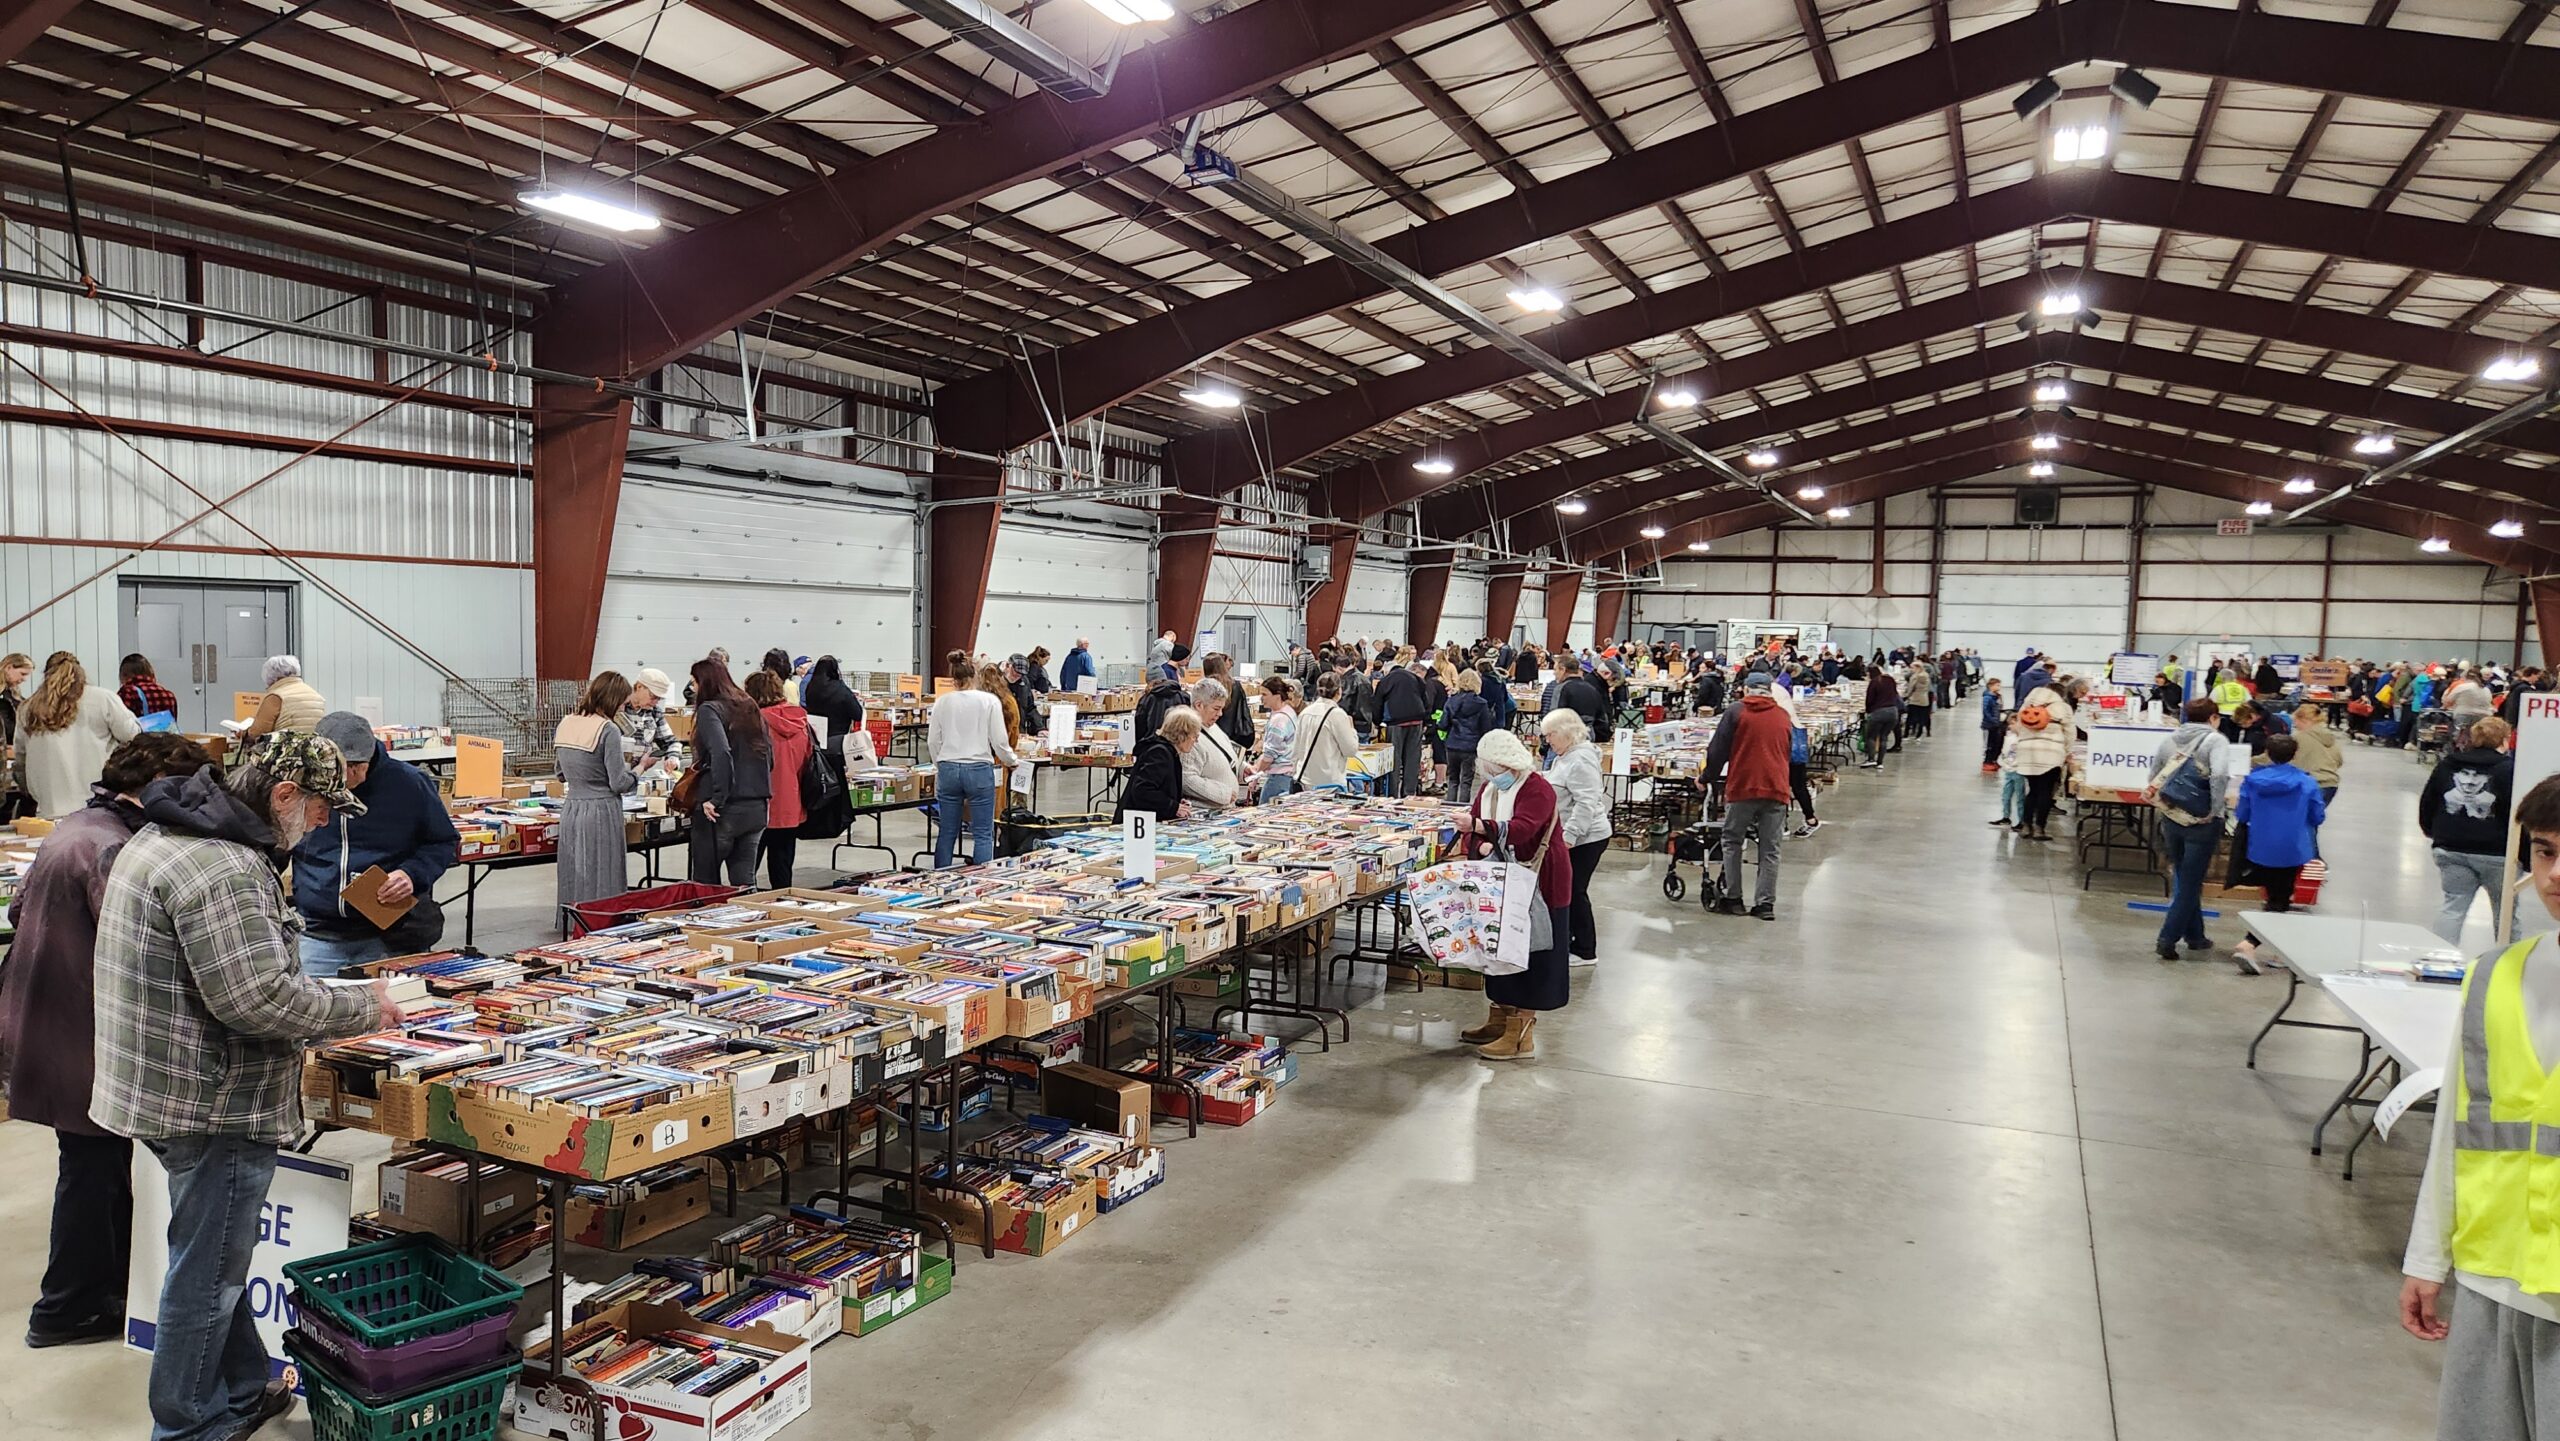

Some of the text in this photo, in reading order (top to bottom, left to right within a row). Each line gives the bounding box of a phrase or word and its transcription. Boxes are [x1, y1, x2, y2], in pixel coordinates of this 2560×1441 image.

[2528, 697, 2560, 719] PR
[1123, 719, 1130, 731] C
[468, 739, 491, 749] ANIMALS
[1621, 731, 1627, 743] P
[1134, 816, 1145, 839] B
[1057, 1006, 1064, 1020] B
[795, 1090, 803, 1106] B
[518, 1119, 537, 1129] TABLE
[664, 1124, 675, 1146] B
[492, 1131, 530, 1155] Grapes
[760, 1375, 767, 1386] B
[602, 1387, 681, 1409] INFINITE POSSIBILITIES
